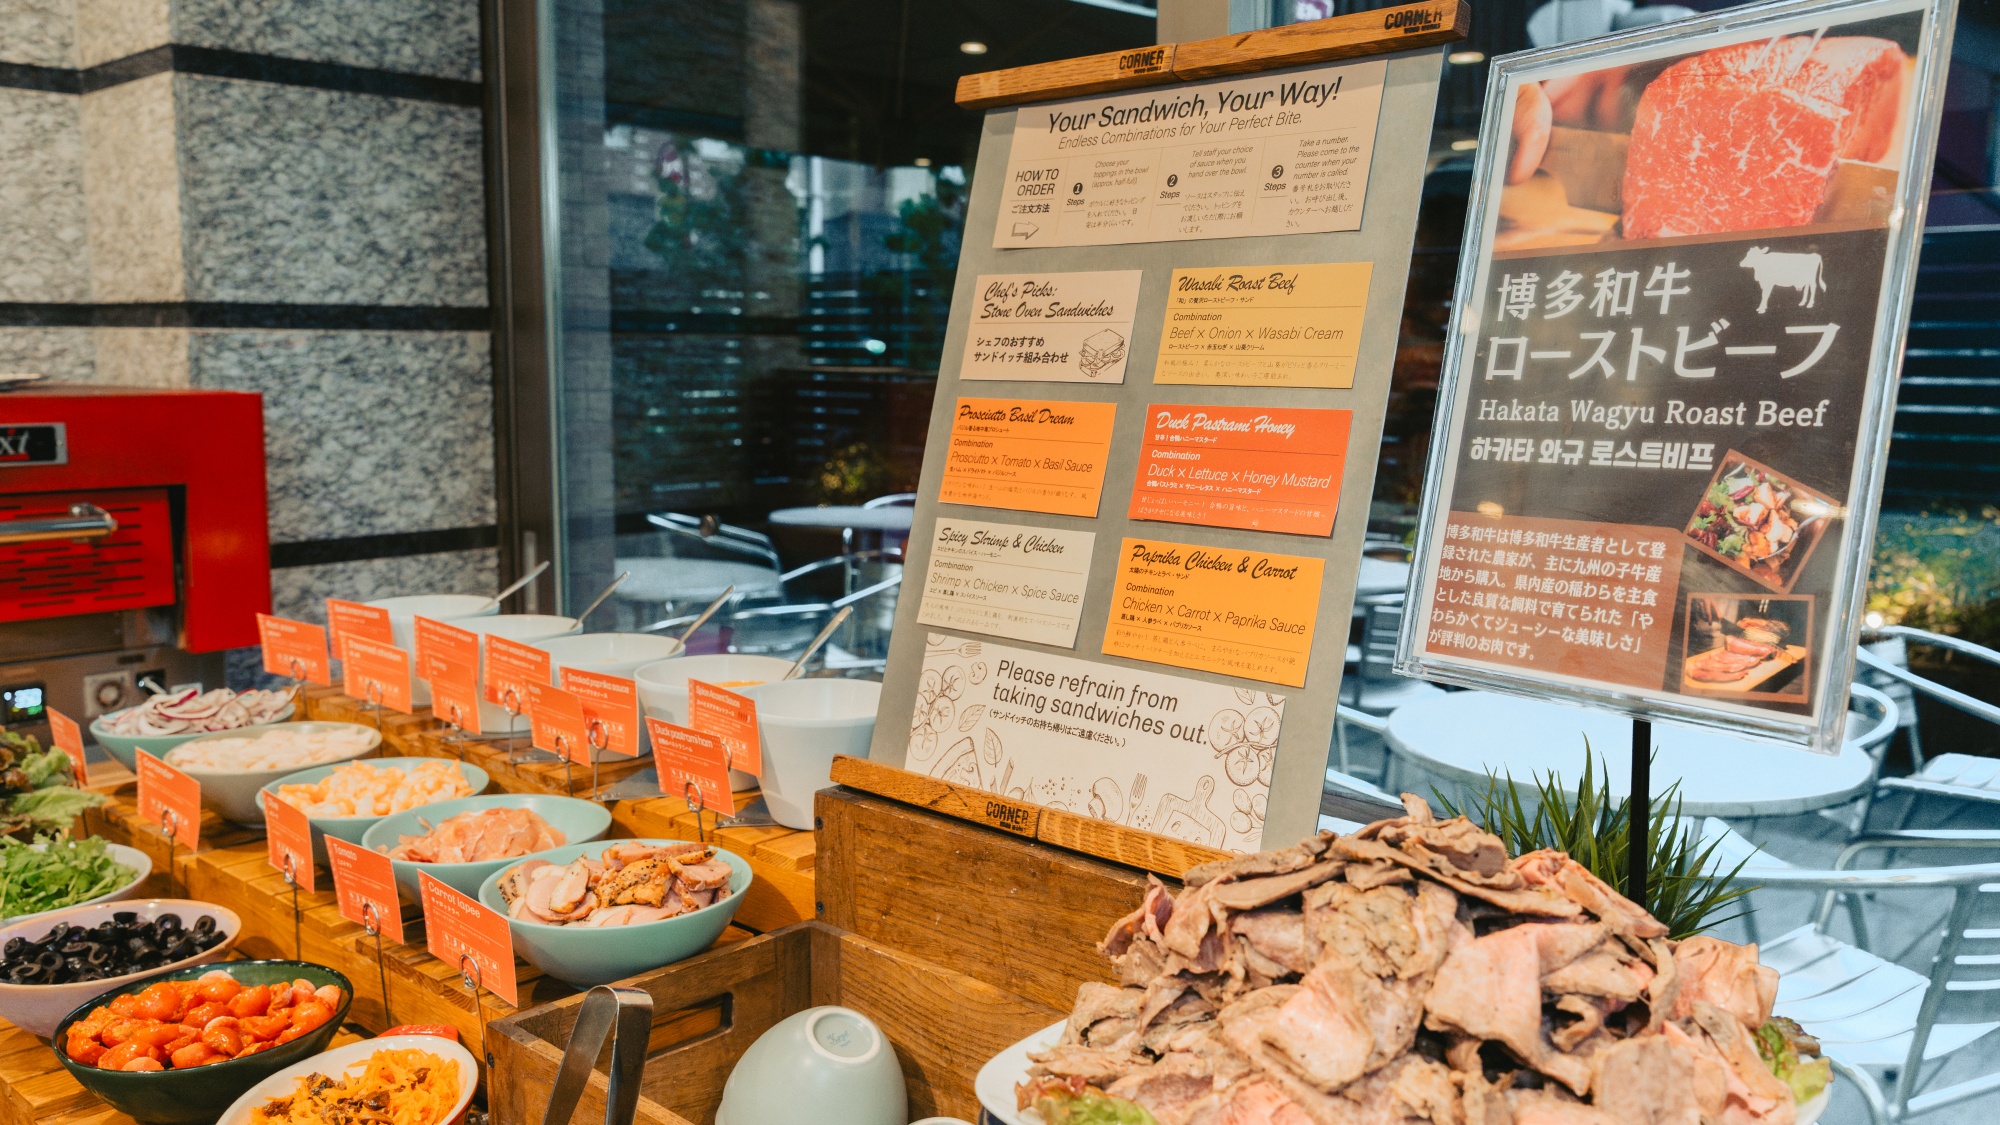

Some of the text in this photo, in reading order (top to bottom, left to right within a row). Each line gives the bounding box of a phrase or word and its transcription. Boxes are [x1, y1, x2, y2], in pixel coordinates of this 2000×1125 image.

[1384, 9, 1442, 30] CORNER
[1119, 49, 1164, 70] CORNER
[1049, 76, 1342, 134] Your Sandwich, Your Way!
[1058, 112, 1302, 150] Endless Combinations for Your Perfect Bite.
[1322, 136, 1348, 145] number.
[1203, 149, 1217, 157] staff
[1217, 148, 1231, 157] your
[1234, 157, 1246, 165] you
[1297, 150, 1319, 158] Please
[1320, 148, 1339, 156] come
[1349, 145, 1360, 153] the
[1116, 160, 1129, 168] your
[1295, 157, 1357, 169] counter when your
[1015, 169, 1059, 182] HOW TO
[1188, 170, 1204, 178] hand
[1293, 170, 1325, 180] number is
[1017, 183, 1055, 196] ORDER
[1160, 191, 1180, 199] Steps
[1264, 182, 1286, 191] Steps
[1012, 204, 1050, 214] ご注文方法
[1066, 198, 1085, 207] Steps
[984, 281, 1058, 303] Chef's Picks:
[1179, 272, 1298, 295] Wasabi Roast Beef
[1497, 262, 1691, 322] 博多和牛
[980, 300, 1113, 318] Stone Oven Sandwiches
[1173, 313, 1222, 321] Combination
[977, 337, 1045, 347] シェフのおすすめ
[1170, 327, 1344, 339] Beef Onion Wasabi Cream
[974, 352, 1069, 363] サンドイッチ組み合わせ
[1485, 318, 1841, 381] ローストビーフ
[959, 405, 1074, 425] Prosciutto Basil Dream
[1478, 399, 1831, 430] Hakata Wagyu Roast Beef
[1156, 412, 1295, 439] Duck Pastrami Honey
[954, 439, 993, 448] Combination
[1471, 436, 1716, 471] 하카타 와규 로스트비프
[951, 451, 1092, 472] Prosciutto Tomato Basil Sauce
[1152, 450, 1200, 460] Combination
[1148, 464, 1331, 489] Duck Lettuce Honey Mustard
[939, 527, 1064, 554] Spicy Shrimp & Chicken
[1446, 524, 1666, 559] 博多和牛は博多和牛生産者として登
[934, 560, 973, 572] Combination
[1131, 544, 1298, 580] Paprika Chicken & Carrot
[1441, 544, 1662, 582] 録された農家が、主に九州の子牛産
[931, 572, 1079, 603] Shrimp Chicken Spice Sauce
[1126, 582, 1174, 596] Combination
[1438, 565, 1658, 606] 地から購入。県内産の稲わらを主食
[1123, 597, 1306, 635] Chicken Carrot Paprika Sauce
[1435, 587, 1654, 630] とした良質な飼料で育てられた「や
[1431, 608, 1642, 654] わらかくてジューシーな美味しさ」
[1428, 628, 1536, 660] が評判のお肉です。
[997, 660, 1178, 713] Please refrain from
[993, 683, 1207, 746] taking sandwiches out.
[654, 724, 670, 736] Duck
[986, 801, 1029, 826] CORNER
[333, 844, 357, 861] Tomato
[428, 881, 456, 904] Carrot
